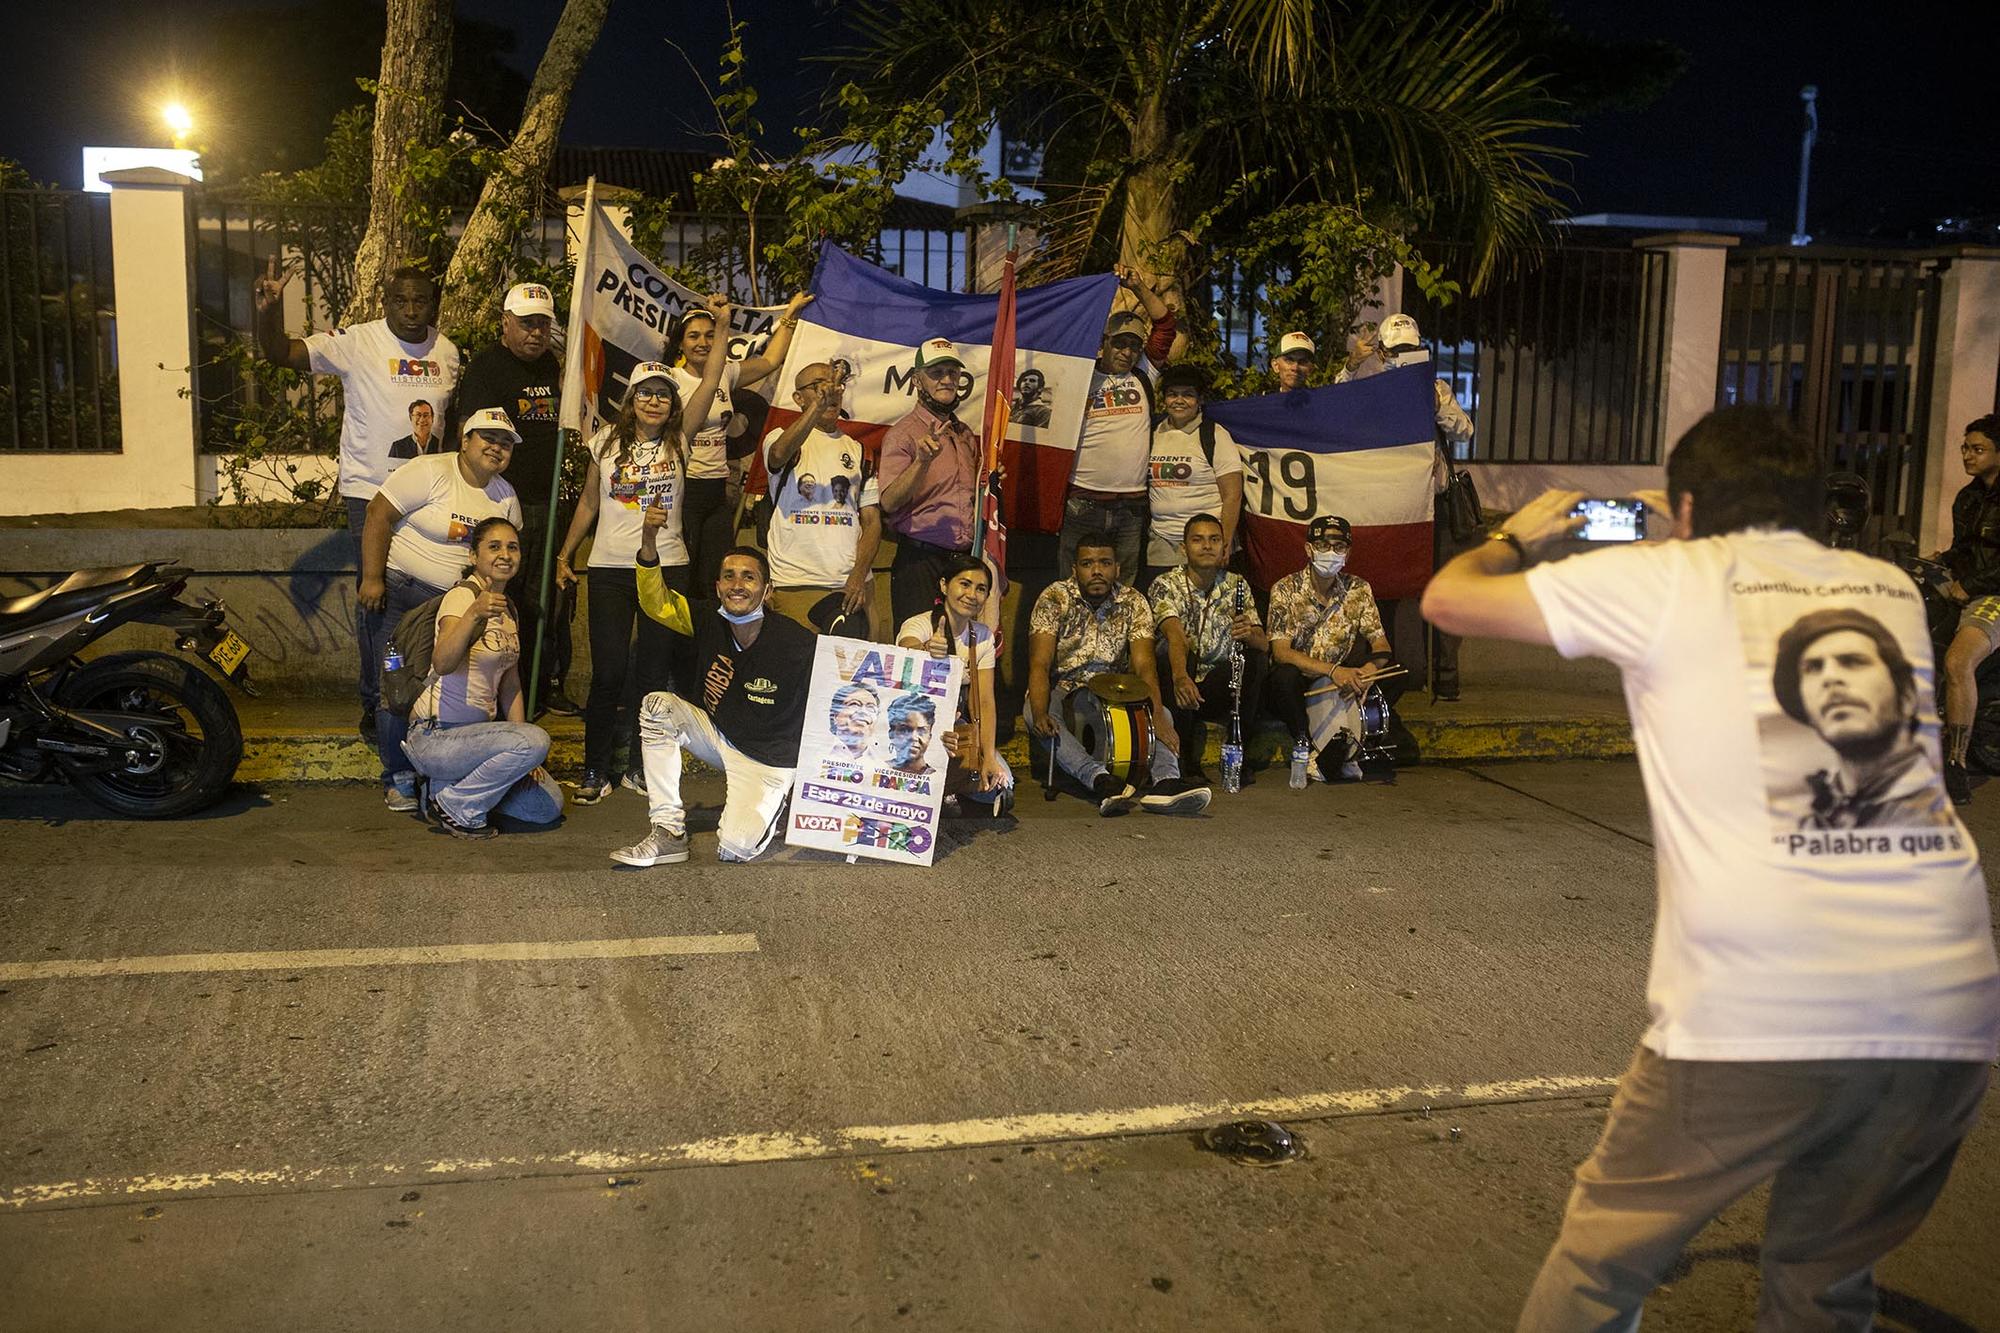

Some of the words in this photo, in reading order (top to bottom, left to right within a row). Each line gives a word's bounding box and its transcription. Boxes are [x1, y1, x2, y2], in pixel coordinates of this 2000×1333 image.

[632, 460, 676, 476] PETRO
[649, 483, 672, 495] 2022
[1815, 583, 1873, 597] Carlos
[834, 644, 951, 698] VALLE
[822, 758, 864, 770] PRESIDENTE
[874, 767, 931, 782] VICEPRESIDENTA
[871, 773, 931, 796] FRANCIA
[808, 786, 839, 804] Este
[841, 791, 862, 807] 29
[864, 796, 884, 812] de
[886, 802, 928, 821] mayo
[797, 815, 841, 832] VOTA
[842, 813, 932, 853] PETRO
[1900, 834, 1945, 857] que
